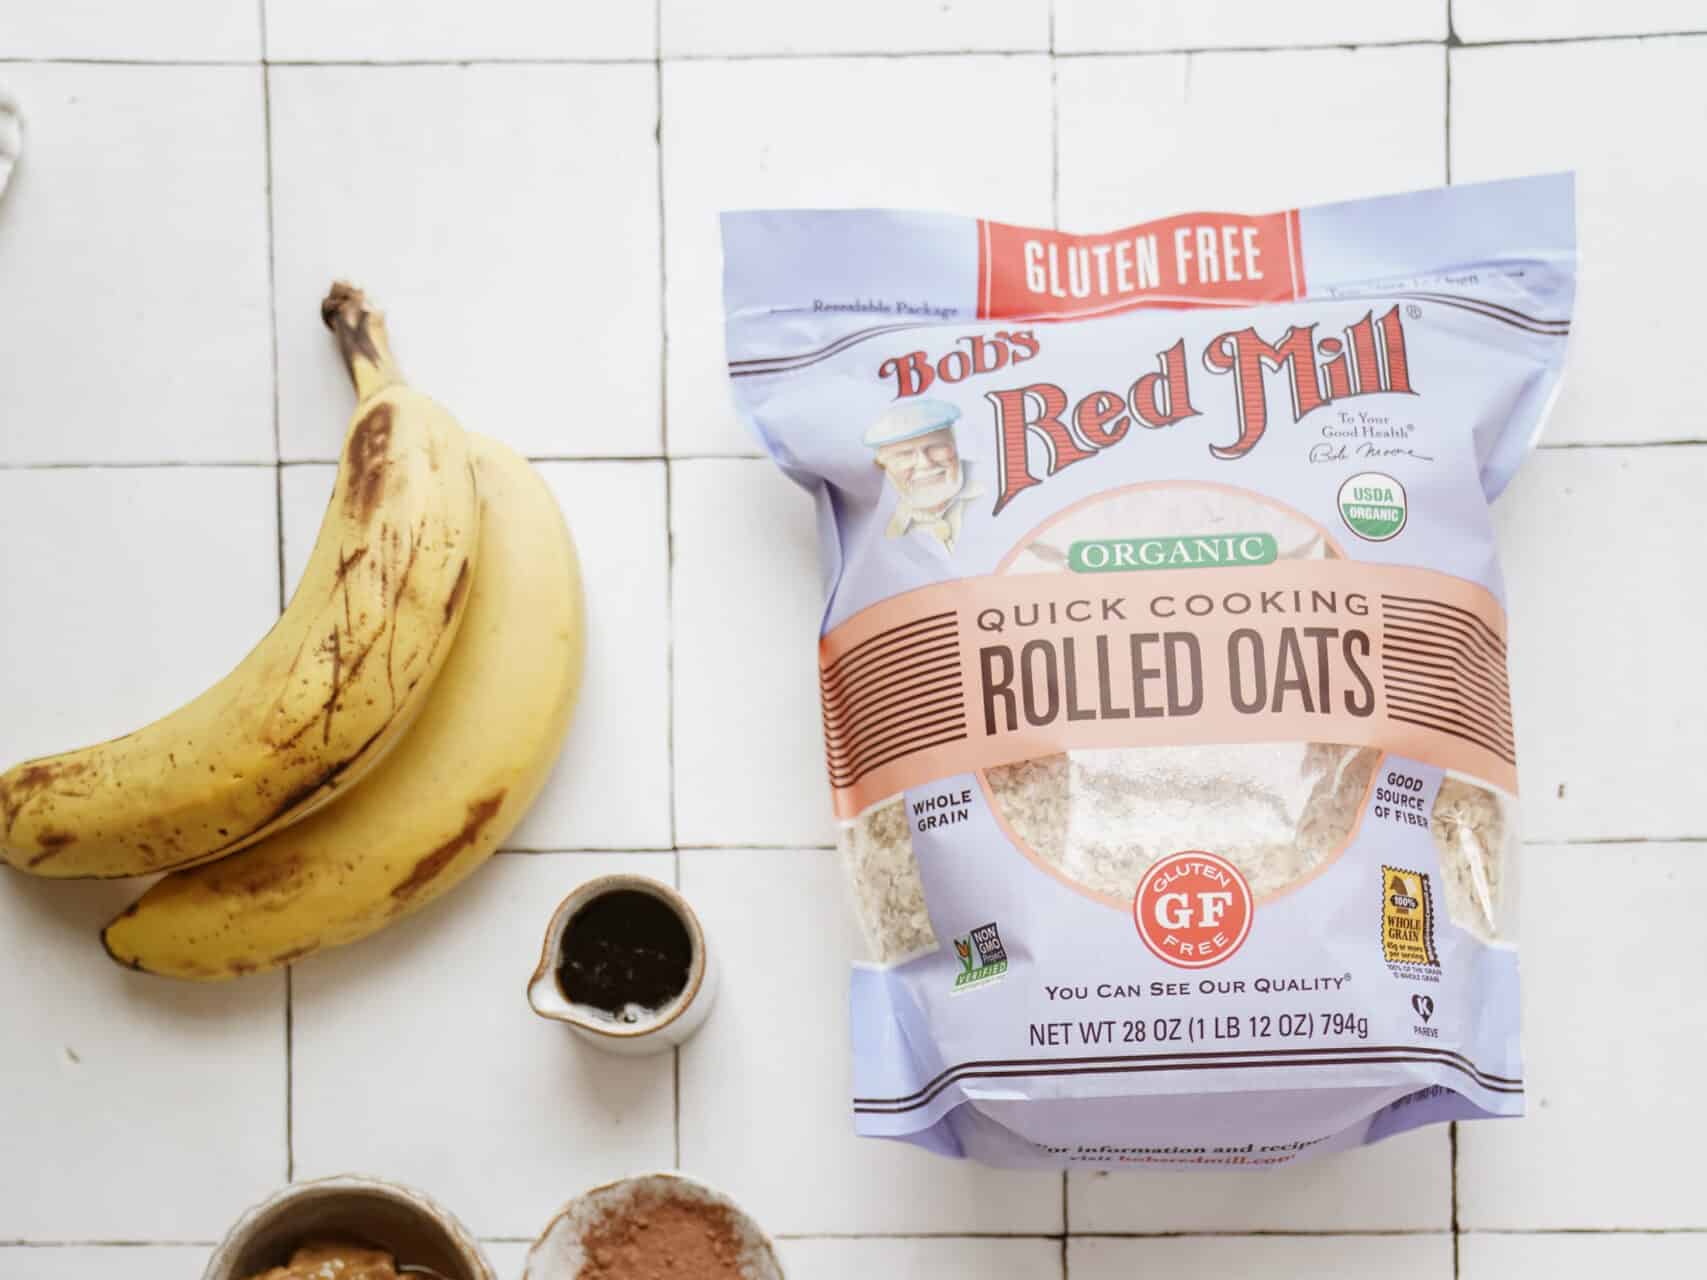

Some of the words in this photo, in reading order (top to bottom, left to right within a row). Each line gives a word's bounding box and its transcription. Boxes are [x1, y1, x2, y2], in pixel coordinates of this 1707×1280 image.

[1024, 234, 1160, 300] GLUTEN
[1175, 226, 1264, 287] FREE
[896, 301, 958, 320] Package
[878, 329, 1041, 400] Bob's
[984, 338, 1203, 517] Red
[1337, 412, 1355, 424] To
[1358, 411, 1391, 424] Your
[1321, 425, 1358, 438] Good
[1353, 488, 1393, 502] USDA
[1349, 506, 1399, 522] ORGANIC
[1080, 536, 1264, 568] ORGANIC
[977, 597, 1127, 632] QUICK
[1150, 590, 1370, 617] COOKING
[979, 631, 1203, 736] ROLLED
[1226, 627, 1375, 718] OATS
[1387, 772, 1423, 792] GOOD
[912, 789, 972, 816] WHOLE
[1376, 787, 1424, 811] SOURCE
[917, 808, 969, 832] GRAIN
[1375, 805, 1391, 819] OF
[1395, 810, 1429, 828] FIBER
[1153, 863, 1231, 893] GLUTEN
[1155, 892, 1233, 929] GF
[1393, 896, 1417, 908] 100%
[974, 925, 996, 943] NON
[1387, 915, 1421, 930] WHOLE
[979, 938, 1001, 953] GMO
[1162, 932, 1229, 956] FREE
[1388, 928, 1419, 942] GRAIN
[958, 961, 1006, 984] VERIFIED
[1030, 1022, 1072, 1046] NET
[1079, 1020, 1116, 1045] WT
[1122, 1019, 1146, 1043] 28
[1153, 1018, 1182, 1041] OZ
[1188, 1016, 1205, 1043] (1
[1214, 1015, 1240, 1039] LB
[1249, 1014, 1271, 1038] 12
[1278, 1012, 1314, 1039] OZ)
[1320, 1012, 1368, 1038] 794g
